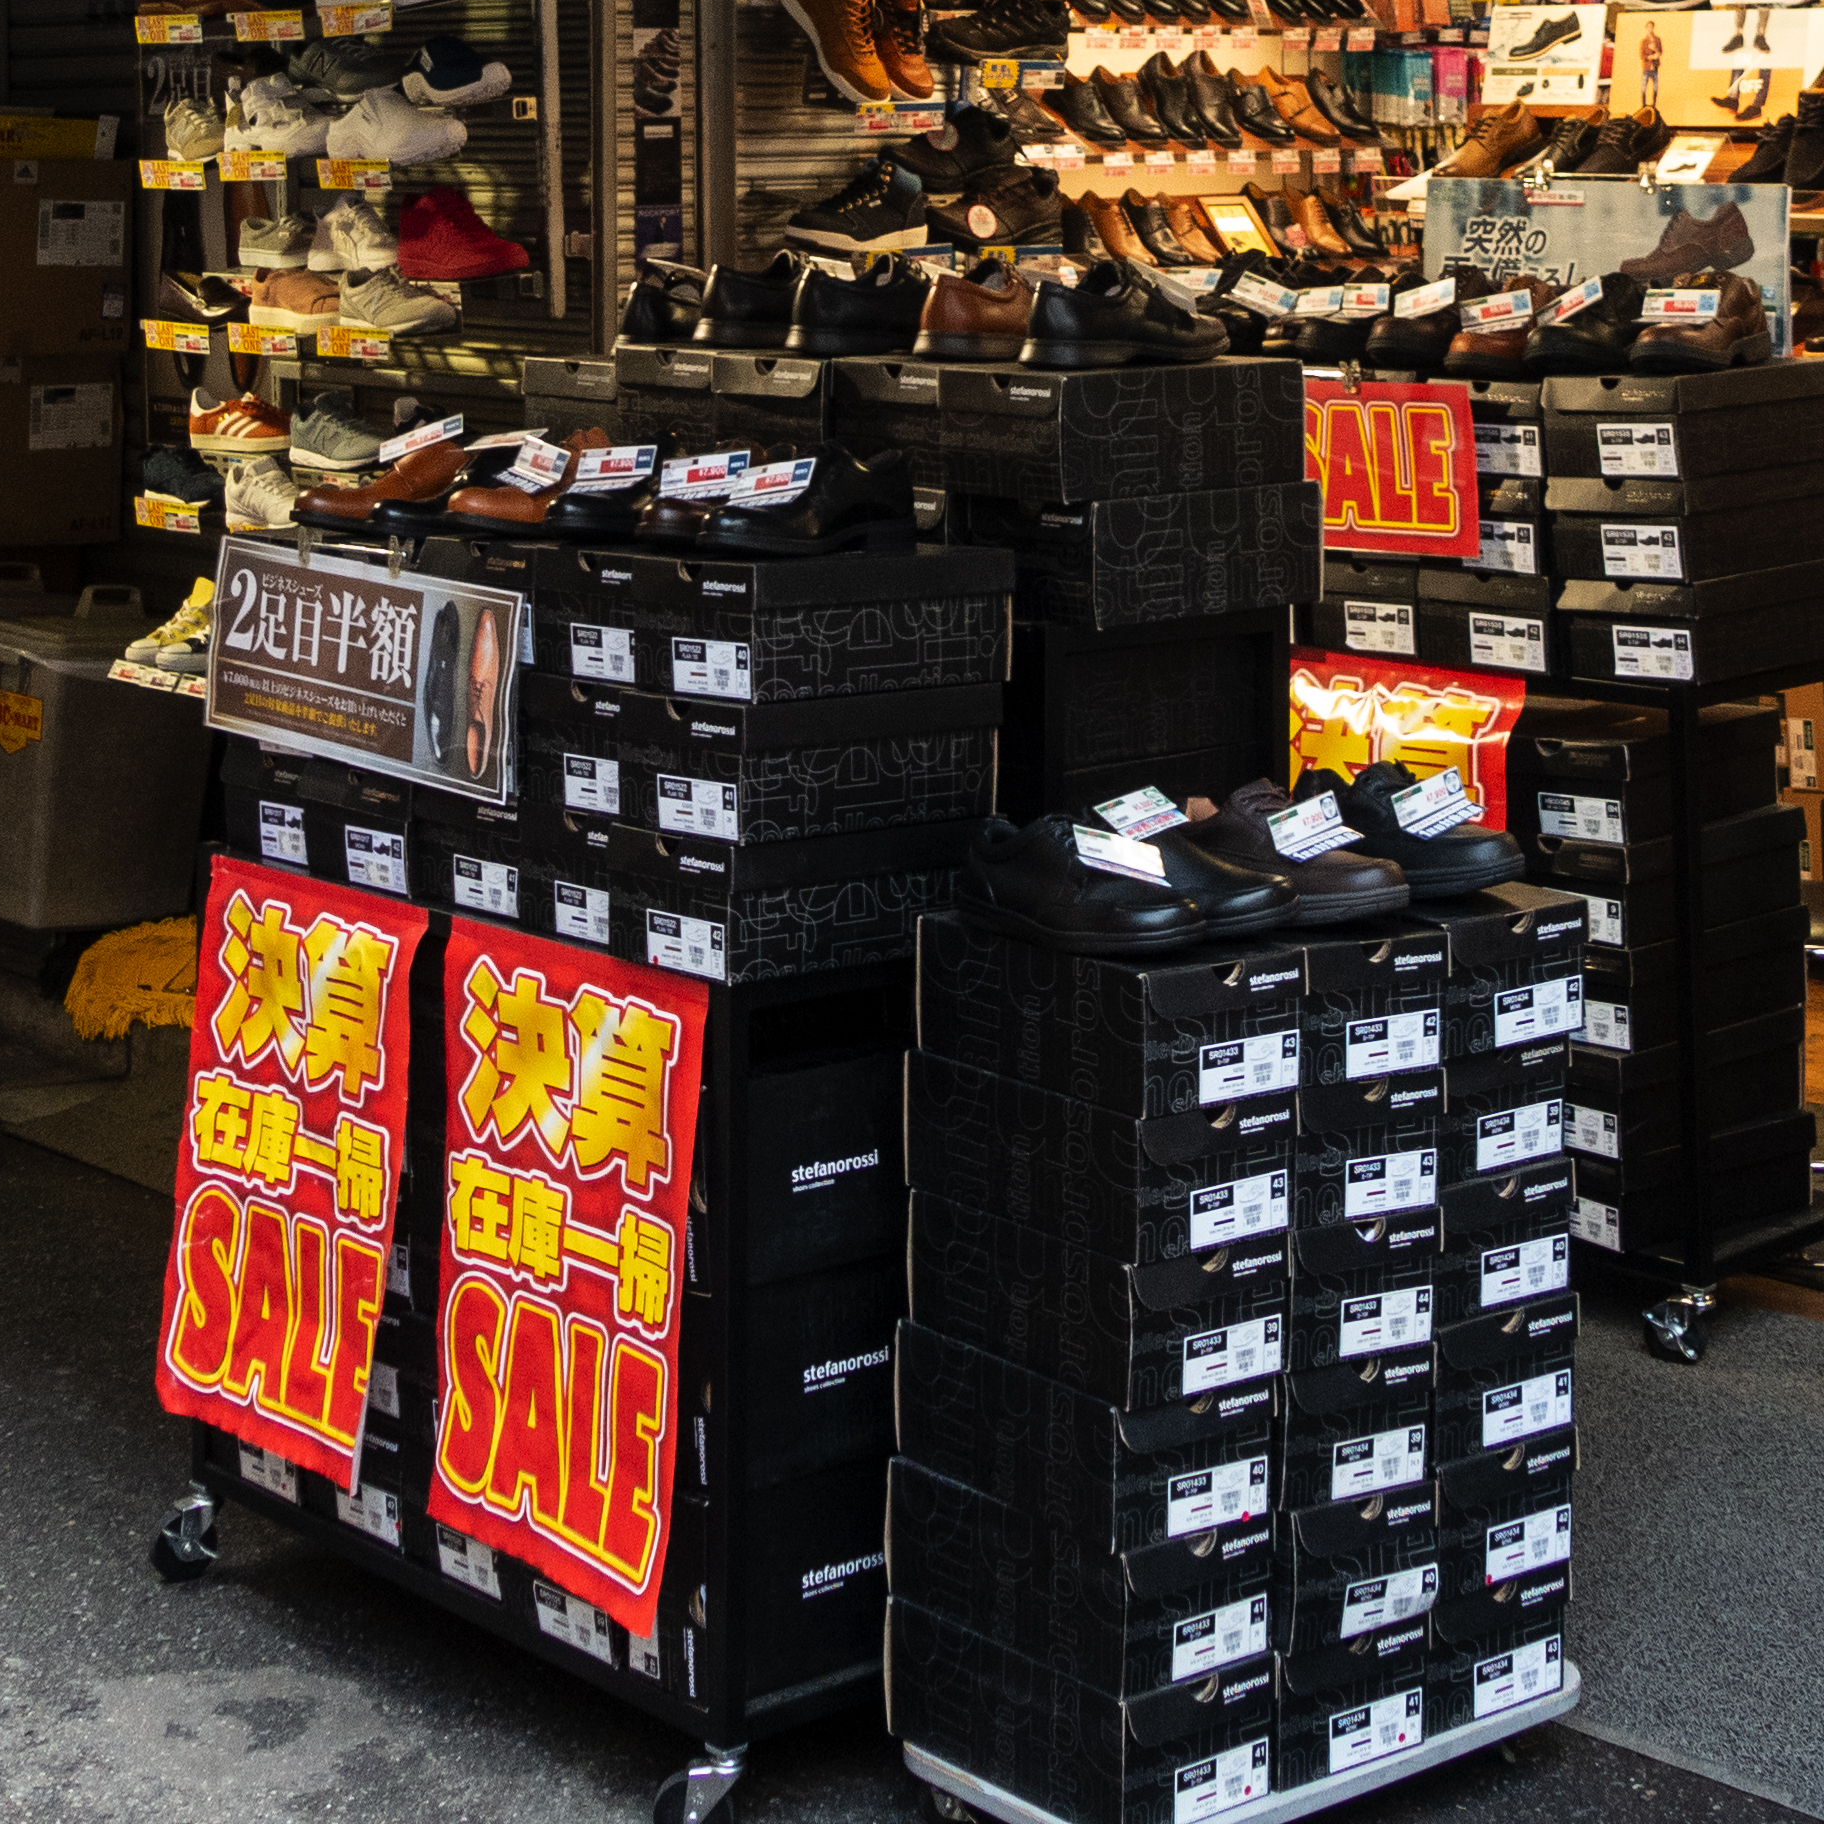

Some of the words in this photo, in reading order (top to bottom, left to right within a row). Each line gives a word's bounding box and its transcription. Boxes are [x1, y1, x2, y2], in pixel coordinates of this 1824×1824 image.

[1465, 220, 1547, 256] 突然の
[262, 572, 323, 600] ビジネスシューズ
[702, 579, 747, 594] stefanorossi
[225, 568, 417, 689] 2足目半額
[680, 854, 725, 873] stefanorossi
[1537, 917, 1582, 935] stefanorossi
[1394, 951, 1442, 967] stefanorossi
[223, 898, 392, 1095] 決算
[1568, 981, 1578, 992] 42
[1502, 993, 1529, 1006] SR01434
[1209, 1046, 1239, 1061] SR01433
[1284, 1037, 1296, 1049] 43
[465, 960, 678, 1189] 決算
[1239, 1109, 1290, 1128] stefanorossi
[194, 1074, 388, 1220] 在庫一掃
[791, 1149, 880, 1183] stefanorossi
[450, 1157, 671, 1327] 在庫一掃
[1232, 1251, 1283, 1273] stefanorossi
[177, 1187, 385, 1445] SALE
[1528, 1311, 1574, 1333] stefanorossi
[802, 1346, 890, 1384] stefanorossi
[1219, 1389, 1269, 1413] stefanorossi
[441, 1283, 664, 1590] SALE
